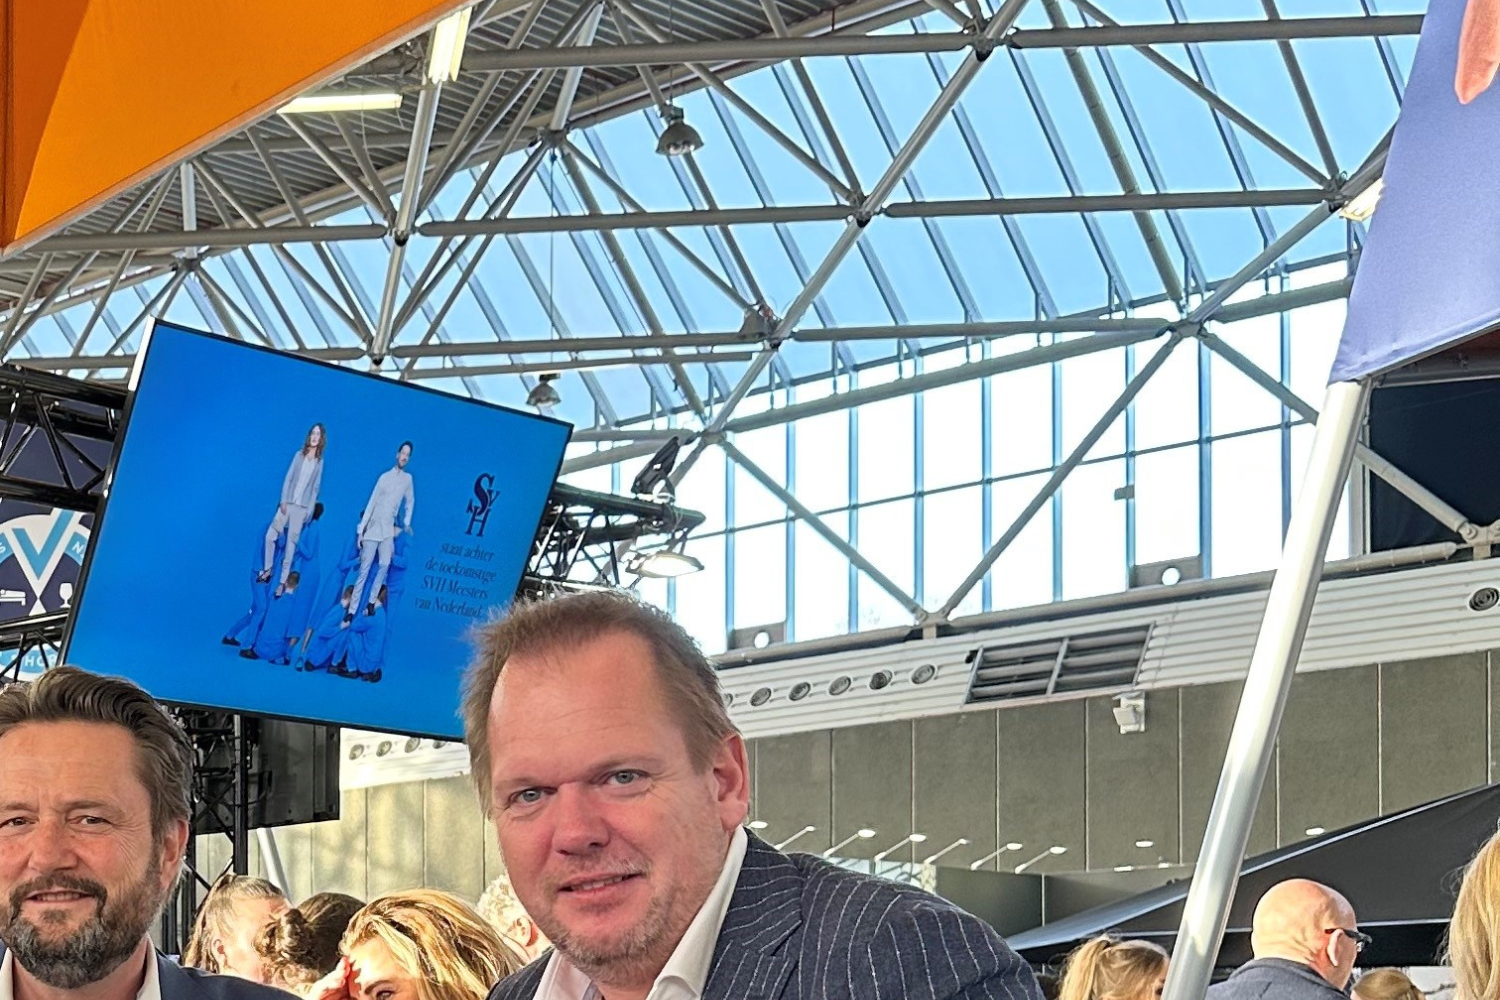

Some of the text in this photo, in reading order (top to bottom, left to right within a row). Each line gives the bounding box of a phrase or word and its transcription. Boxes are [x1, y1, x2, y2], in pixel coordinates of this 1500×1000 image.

[464, 544, 496, 562] achter
[425, 556, 435, 571] de
[422, 574, 489, 600] SVH Meesters
[414, 597, 431, 610] van
